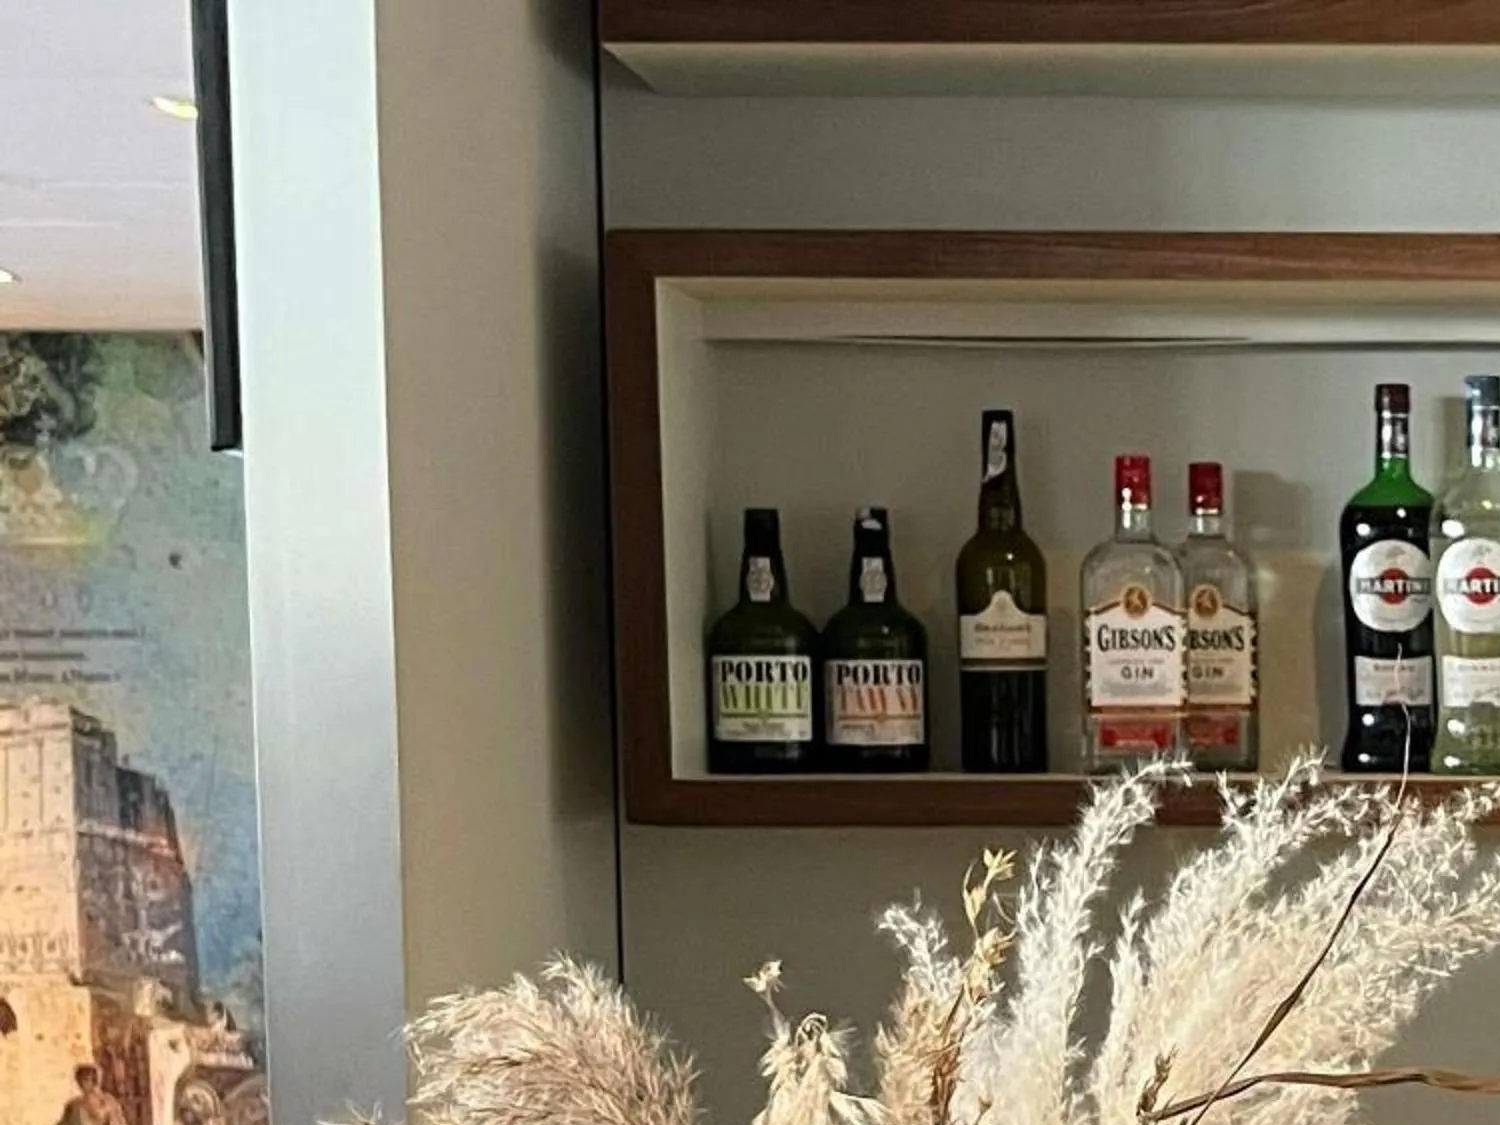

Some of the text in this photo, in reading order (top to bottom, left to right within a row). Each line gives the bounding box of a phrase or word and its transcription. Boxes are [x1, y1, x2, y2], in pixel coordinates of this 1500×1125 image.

[721, 660, 808, 683] PORTO
[836, 663, 920, 686] PORTO
[1121, 666, 1154, 681] GIN
[1192, 666, 1224, 680] GIN
